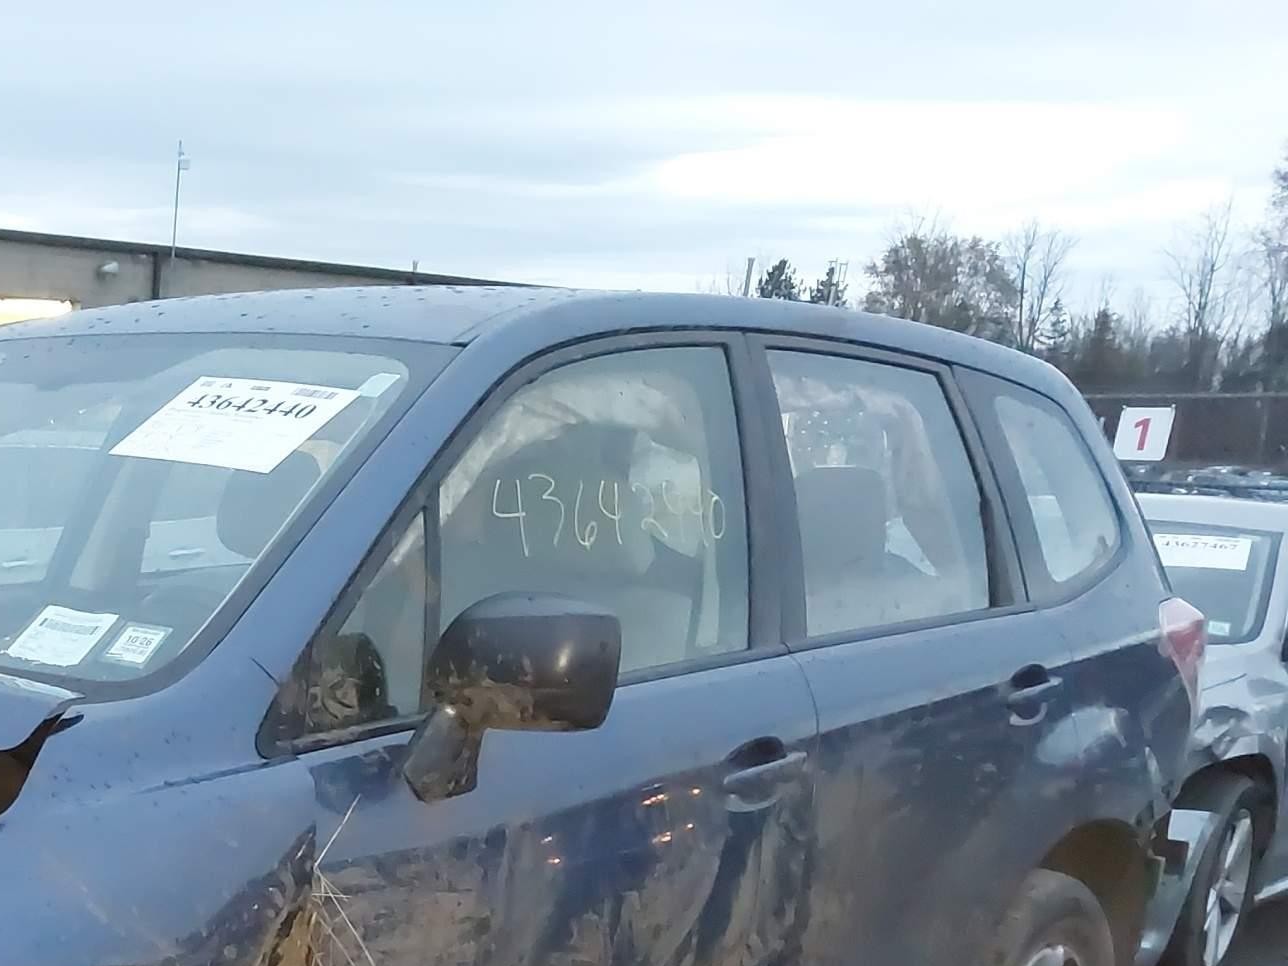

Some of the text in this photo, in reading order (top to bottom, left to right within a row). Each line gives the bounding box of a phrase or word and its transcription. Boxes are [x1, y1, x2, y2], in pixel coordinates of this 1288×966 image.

[187, 393, 317, 419] 43642440
[1134, 418, 1152, 451] 1
[491, 473, 726, 557] 43642440
